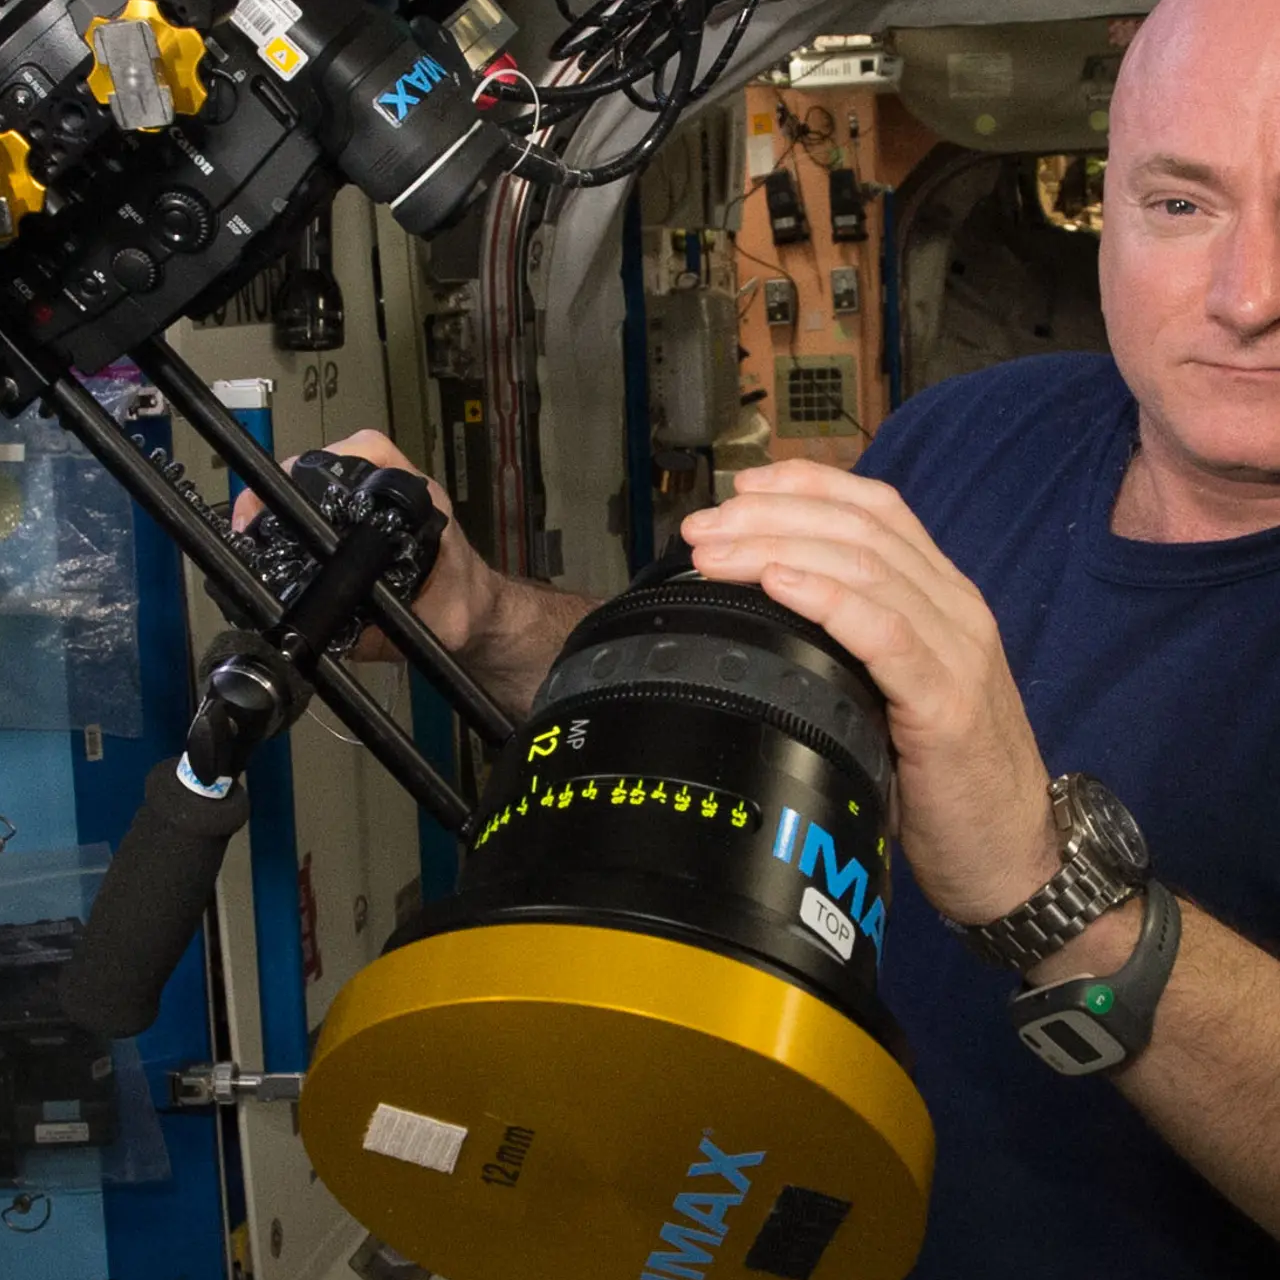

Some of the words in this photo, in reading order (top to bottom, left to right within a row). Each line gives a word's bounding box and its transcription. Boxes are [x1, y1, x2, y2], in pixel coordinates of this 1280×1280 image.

[377, 54, 450, 121] MAX
[168, 125, 214, 176] Canon
[527, 724, 561, 763] 12
[565, 719, 591, 750] MP
[815, 900, 851, 942] TOP
[481, 1125, 535, 1188] 12mm
